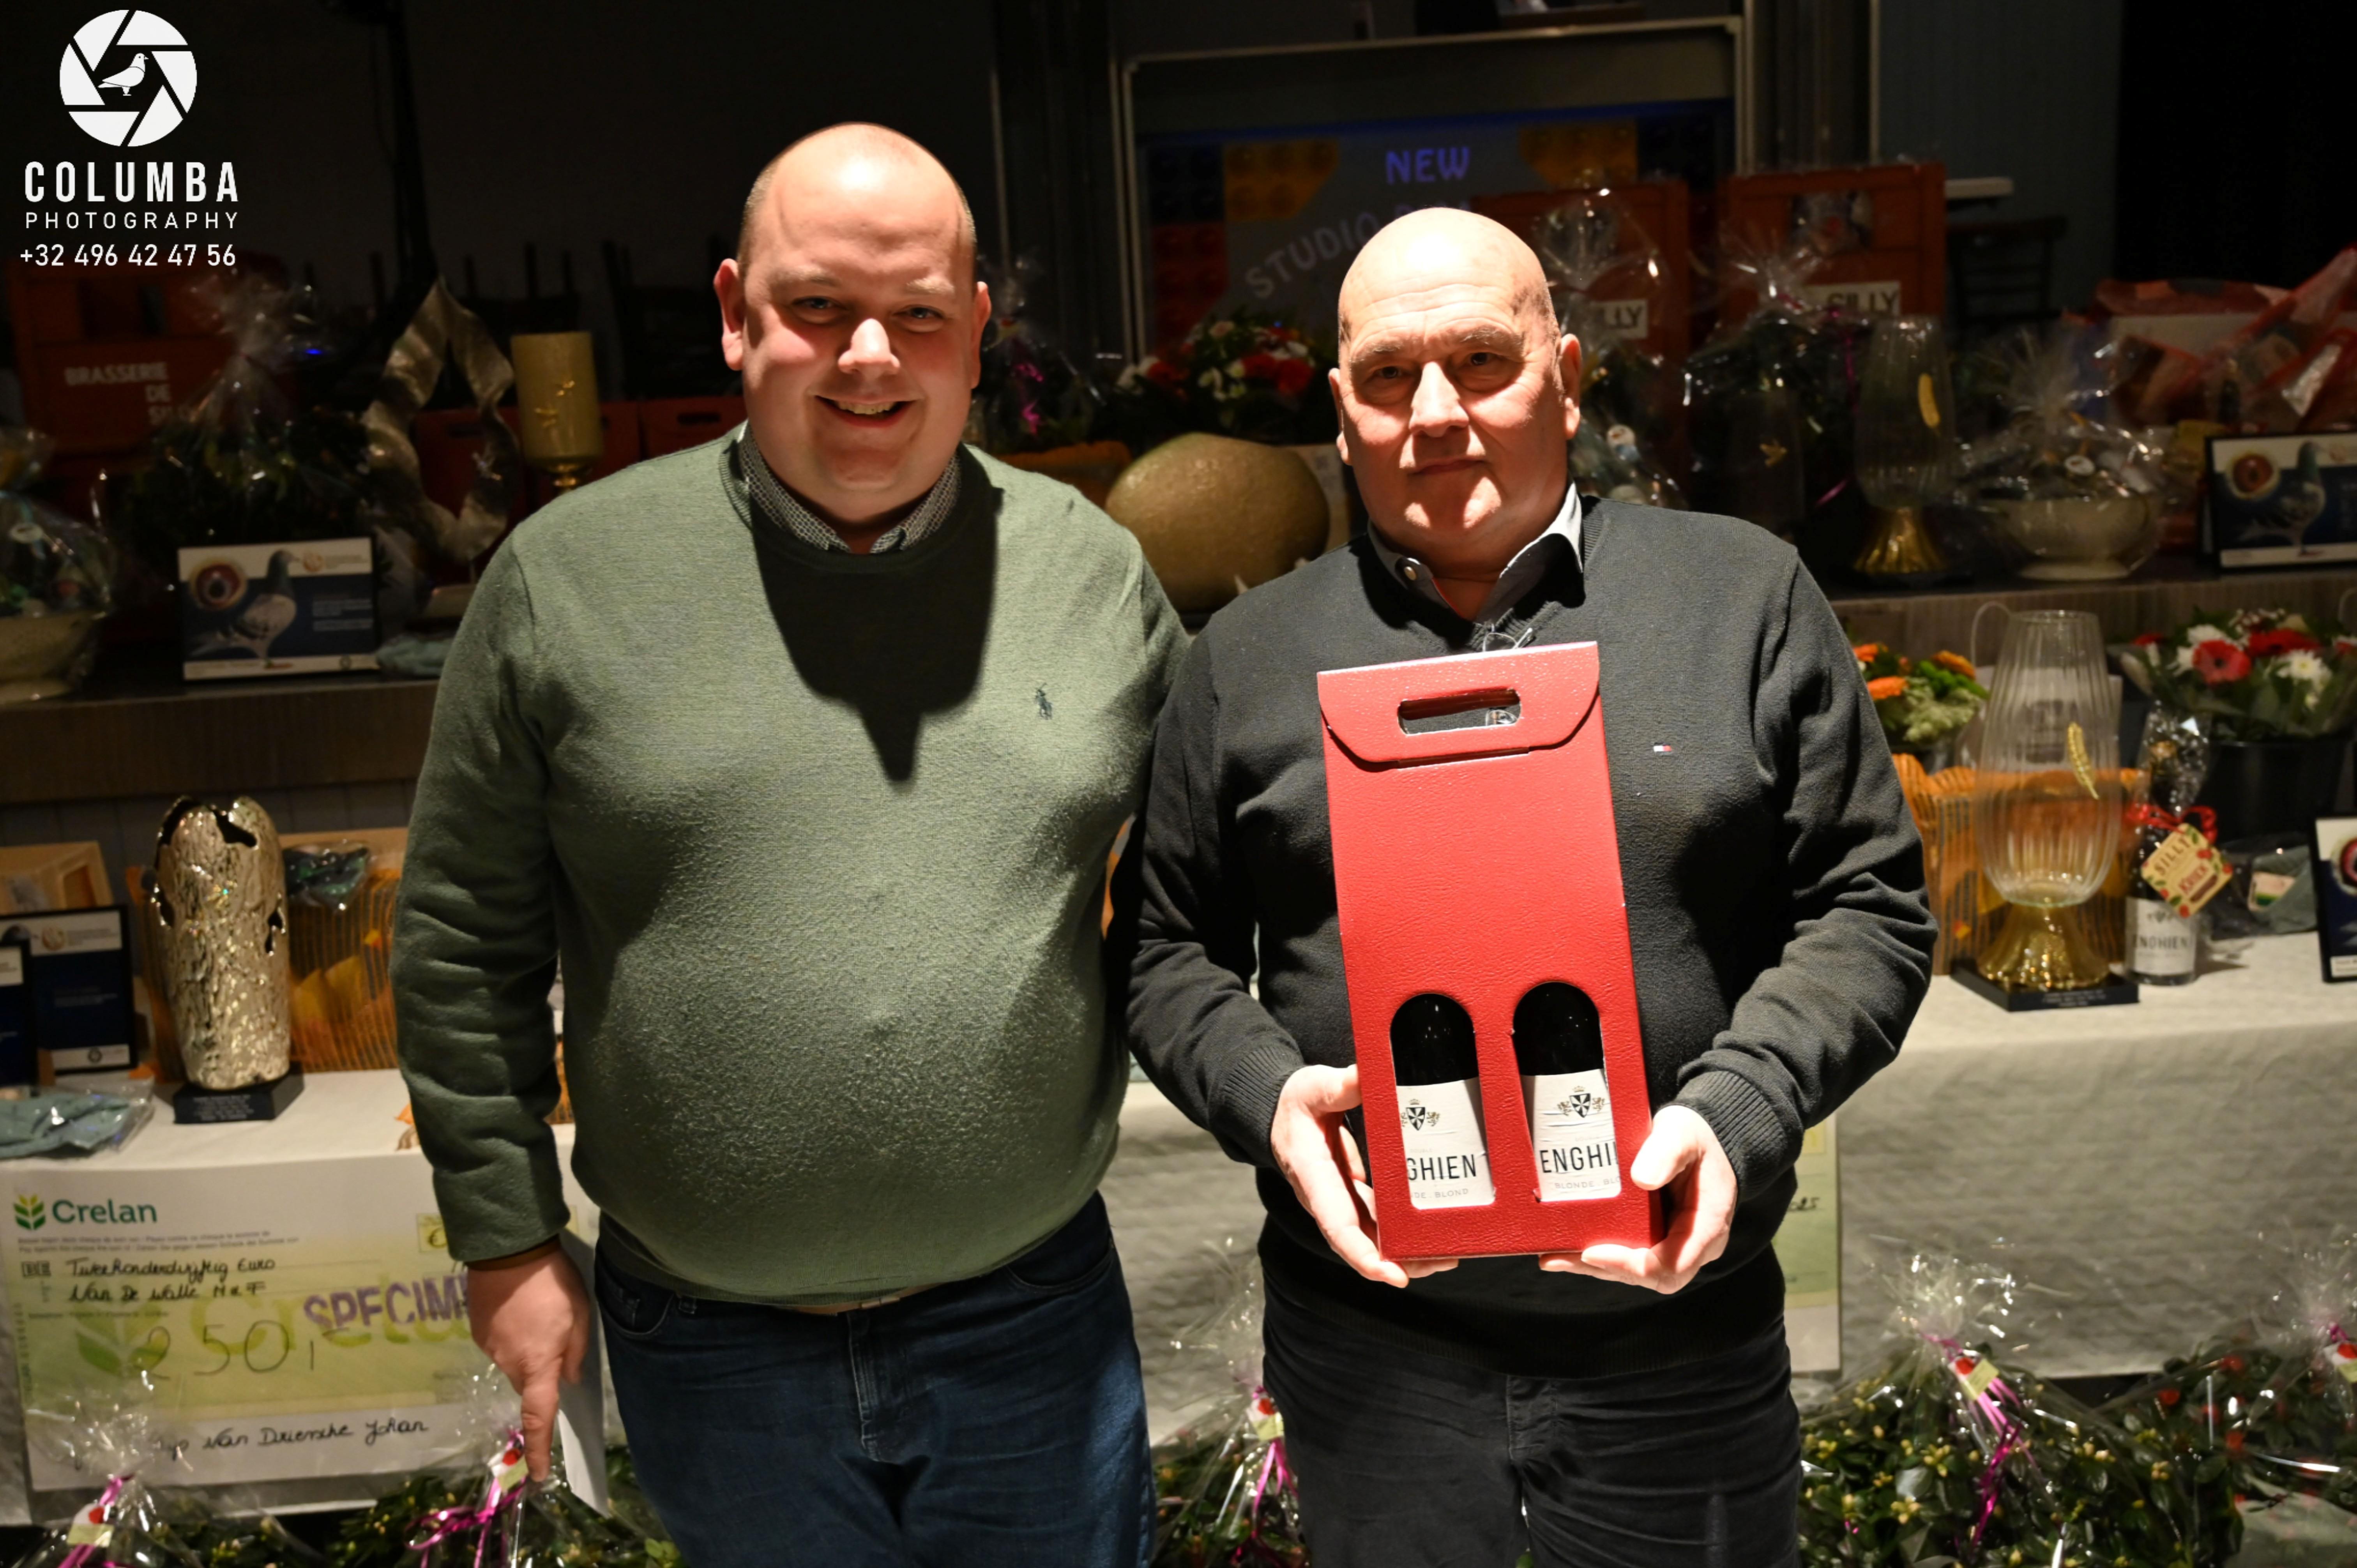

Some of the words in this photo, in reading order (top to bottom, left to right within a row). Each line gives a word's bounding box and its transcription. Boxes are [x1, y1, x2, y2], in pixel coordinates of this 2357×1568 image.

[1385, 146, 1470, 185] NEW
[1245, 212, 1380, 299] STUDIO
[1539, 1141, 1619, 1174] ENGHI
[1555, 1180, 1595, 1189] BLONDE
[52, 1199, 157, 1224] Crelan
